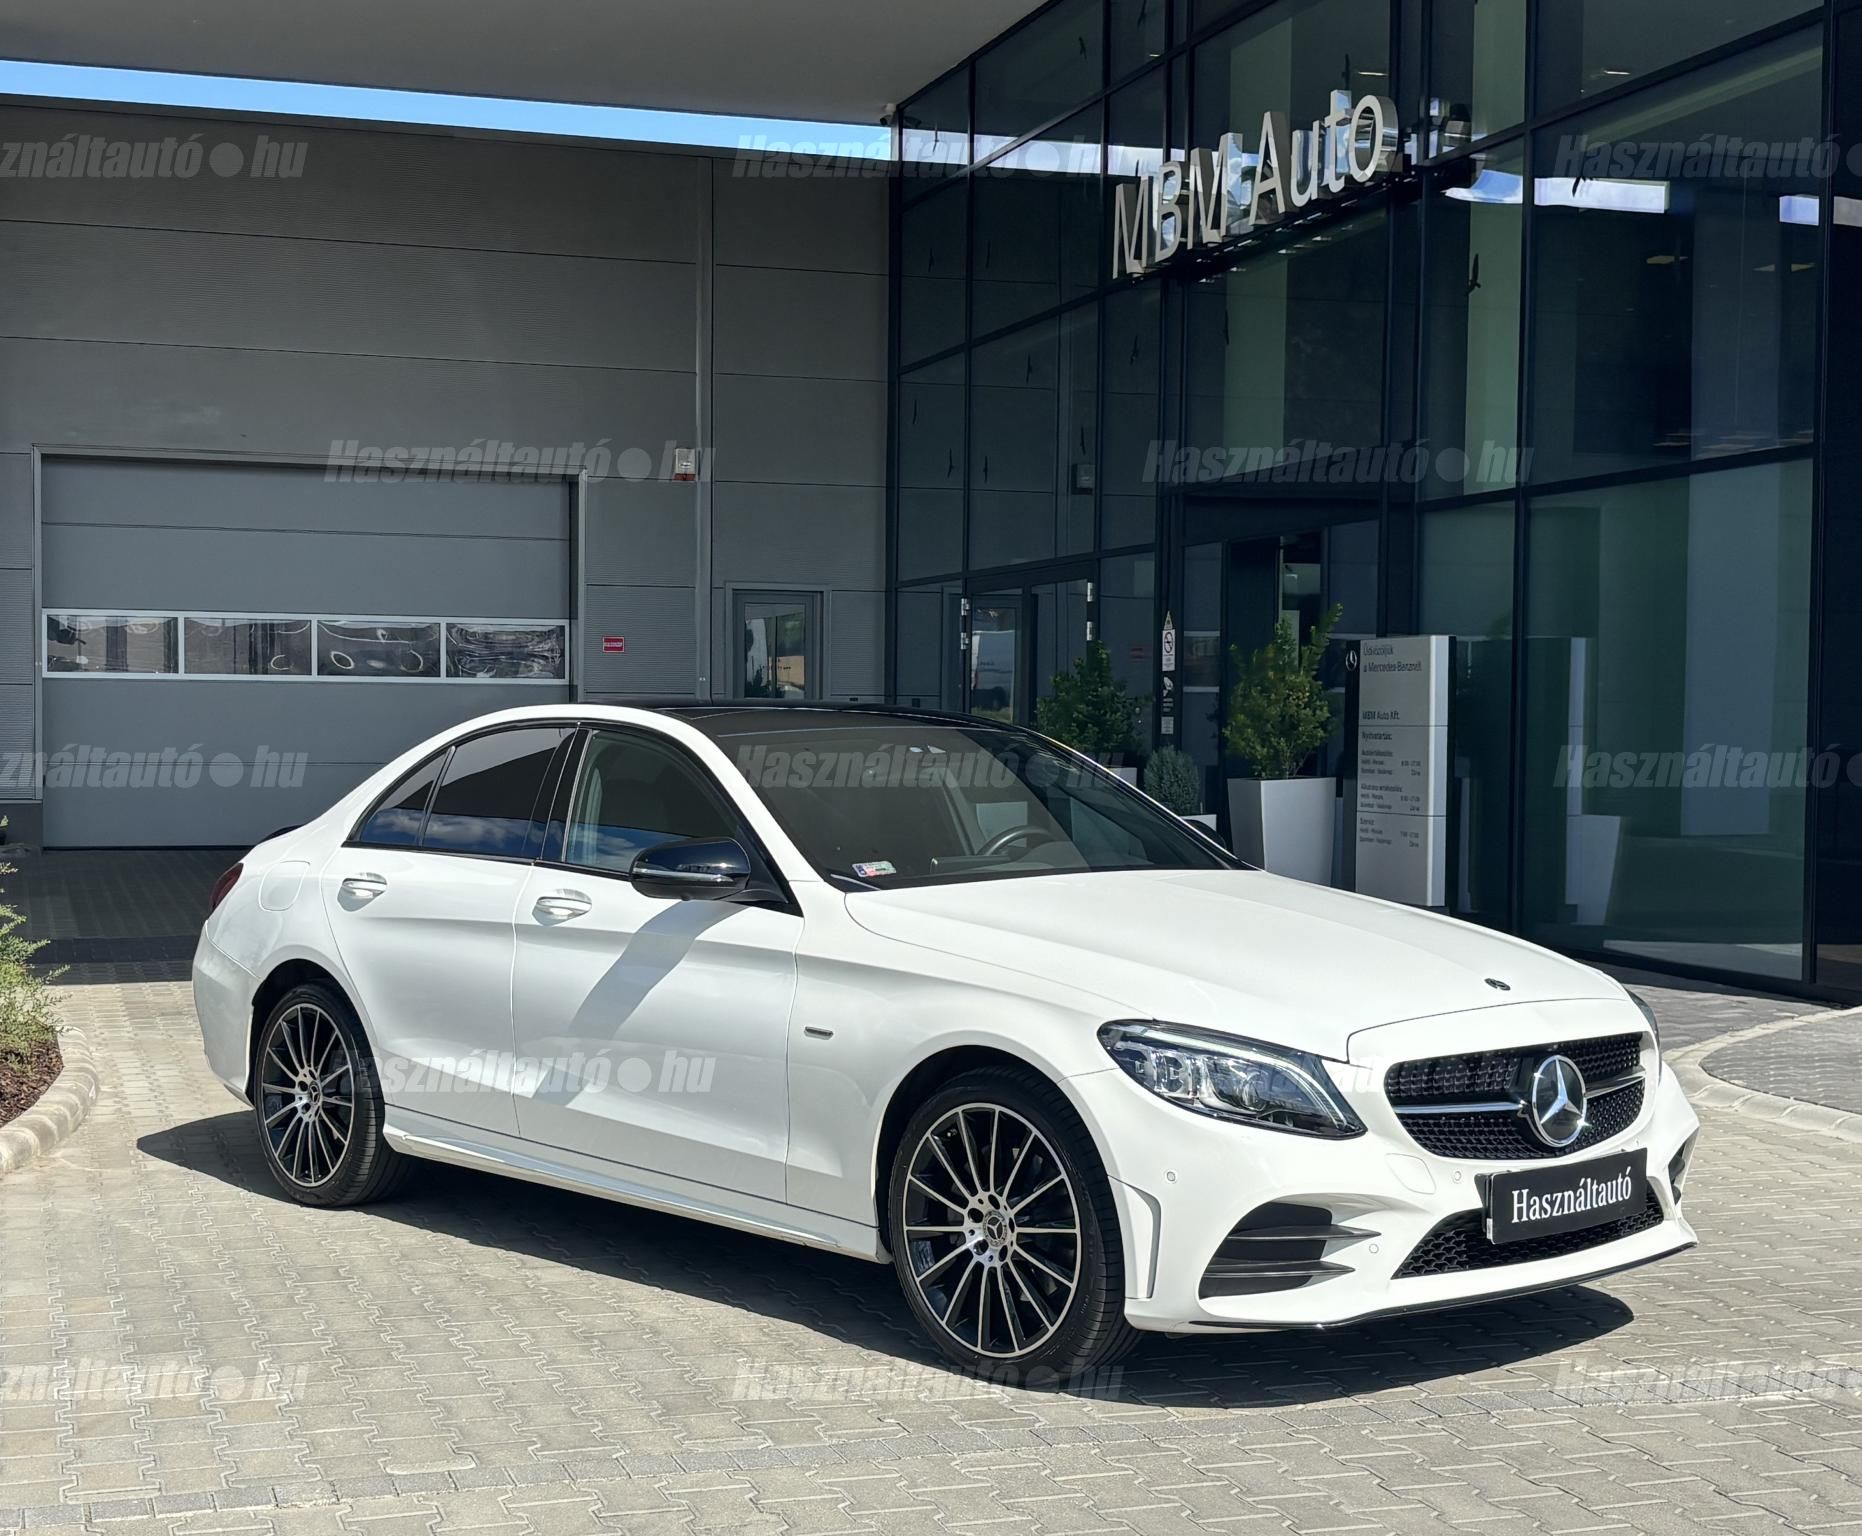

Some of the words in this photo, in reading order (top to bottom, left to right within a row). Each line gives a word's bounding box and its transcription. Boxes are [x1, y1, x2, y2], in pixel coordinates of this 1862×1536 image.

[1112, 132, 1240, 280] MBM
[1250, 89, 1396, 226] Auto
[1511, 1166, 1632, 1223] Használtautó
